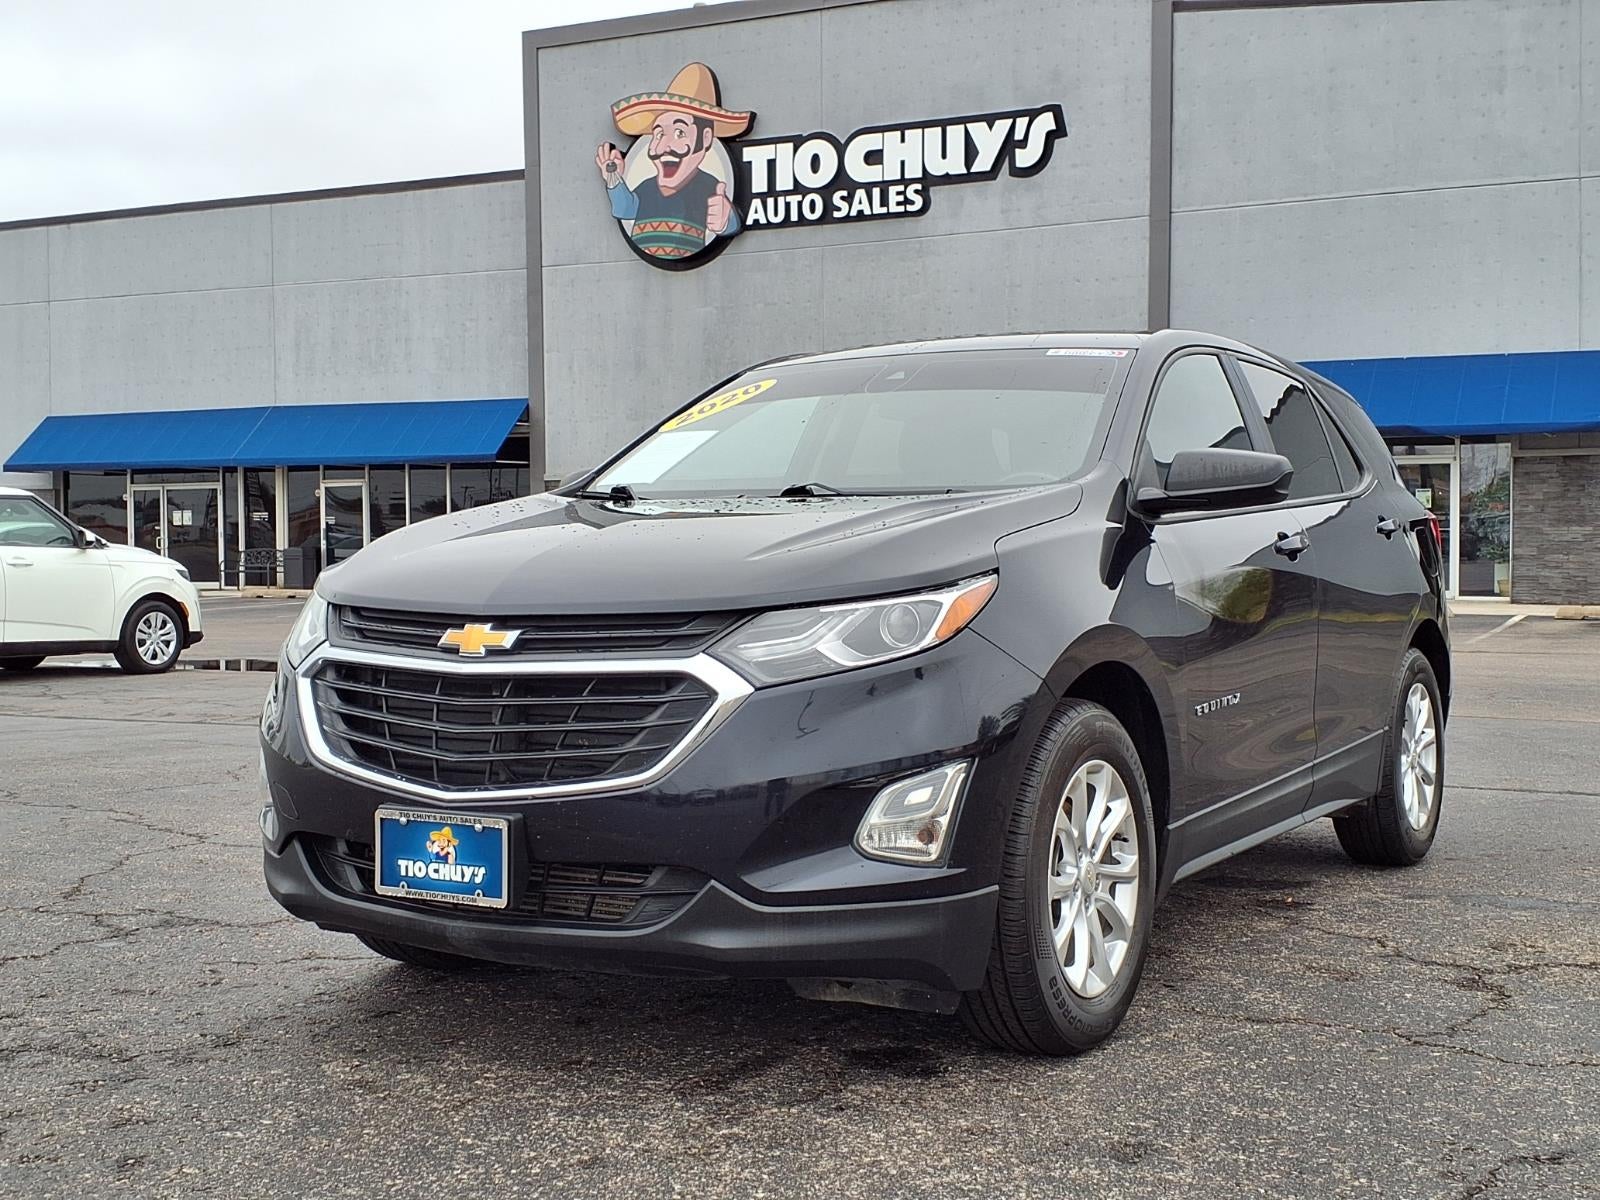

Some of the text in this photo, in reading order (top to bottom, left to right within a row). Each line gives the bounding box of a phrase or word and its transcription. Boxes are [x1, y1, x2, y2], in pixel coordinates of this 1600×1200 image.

[742, 112, 1057, 192] TIO CHUY'S
[746, 183, 924, 225] AUTO SALES
[675, 384, 762, 426] 2020
[412, 812, 437, 821] CHUY'S
[440, 815, 458, 823] AUTO
[397, 859, 486, 884] TIO CHUY'S
